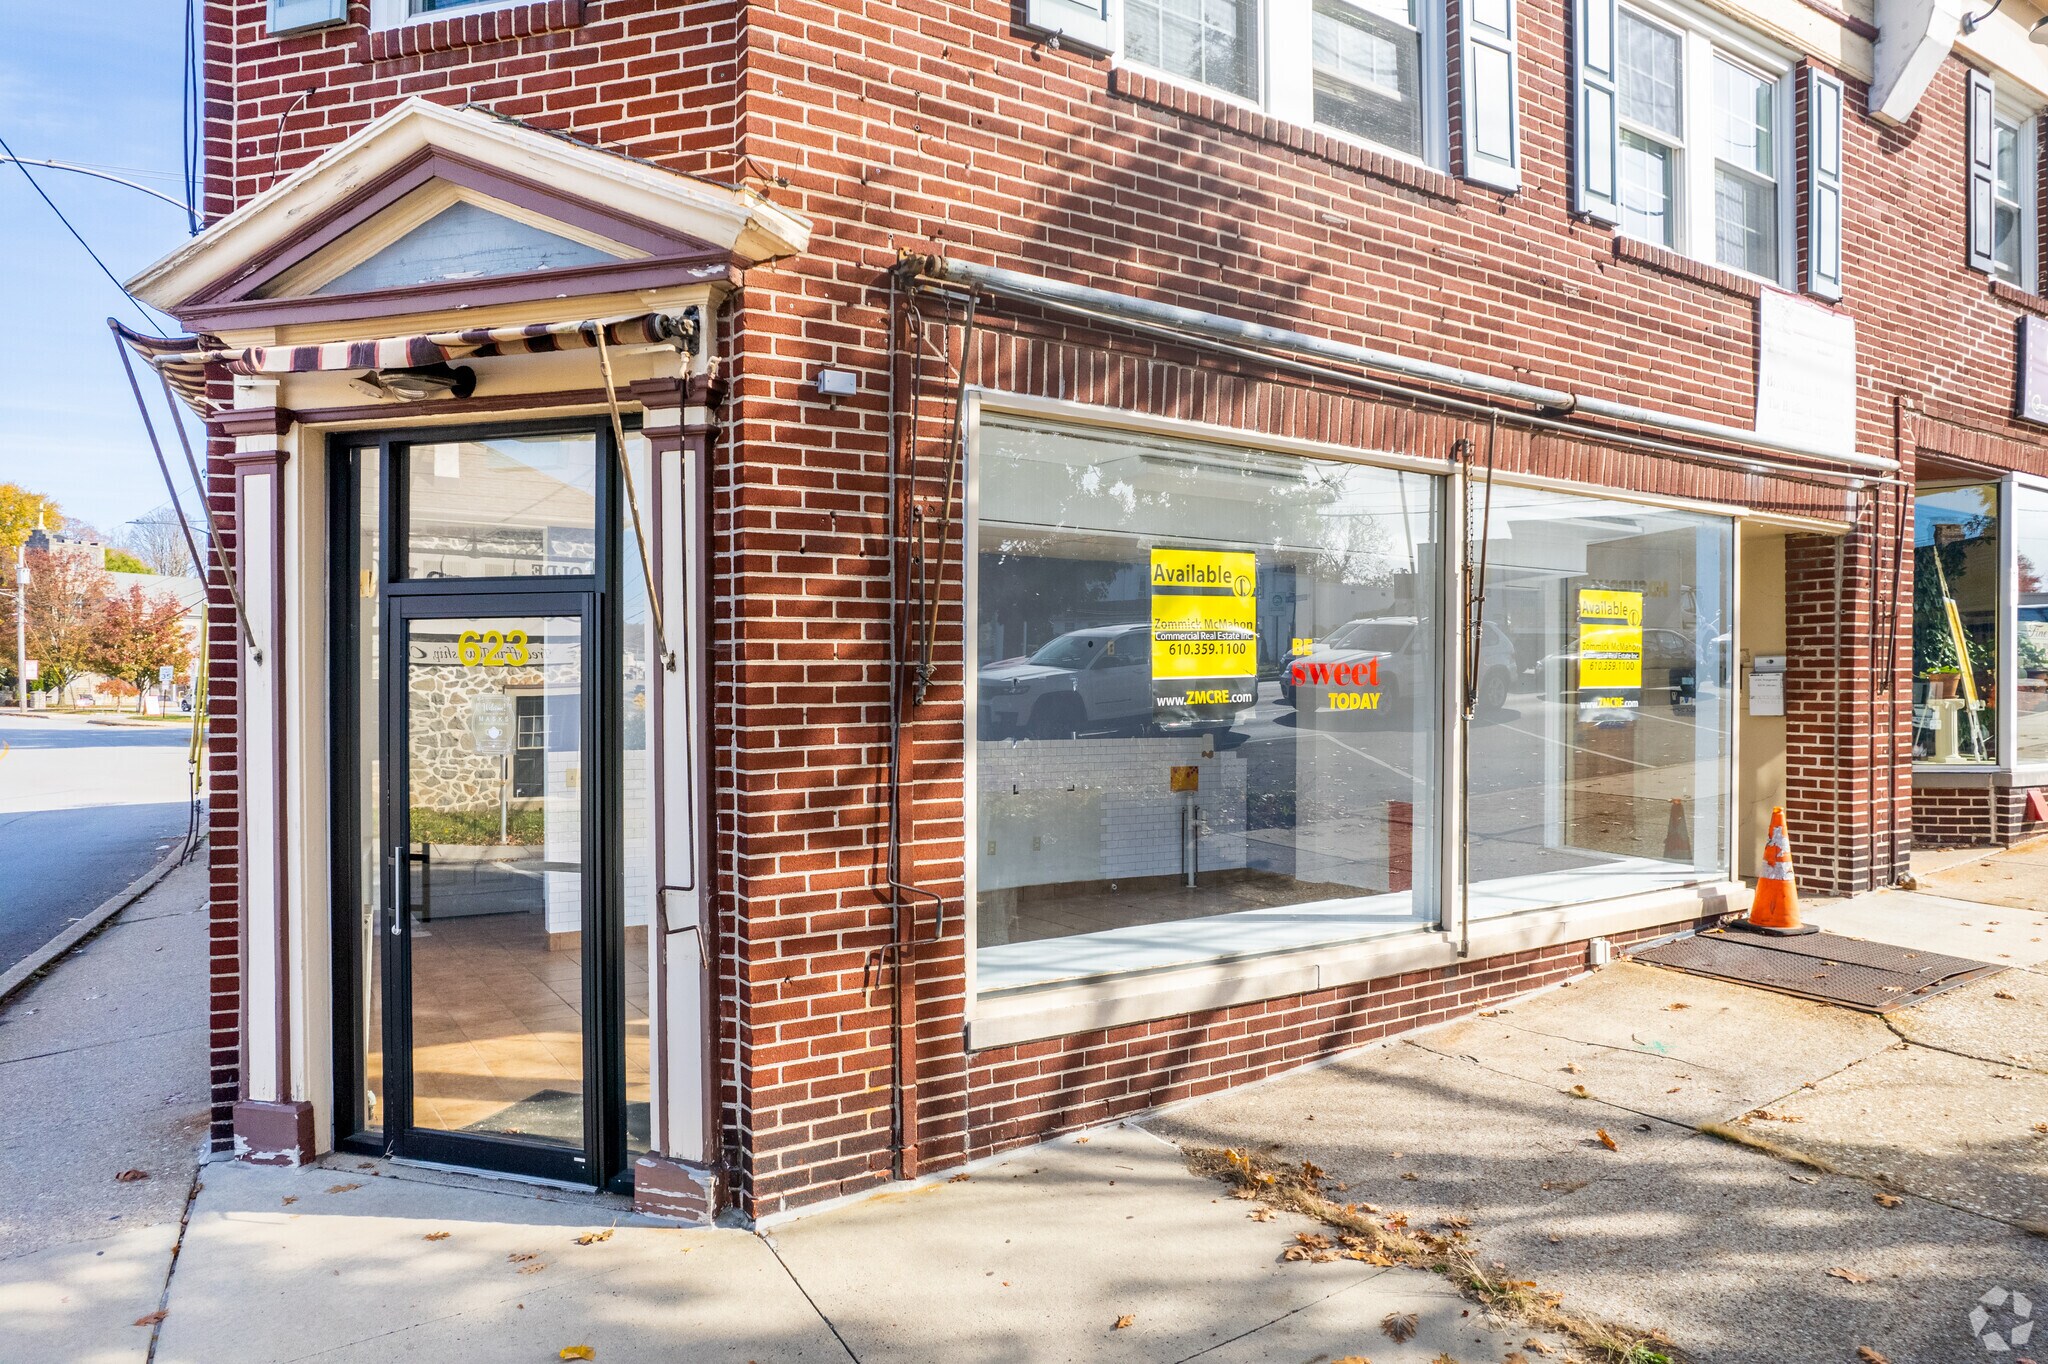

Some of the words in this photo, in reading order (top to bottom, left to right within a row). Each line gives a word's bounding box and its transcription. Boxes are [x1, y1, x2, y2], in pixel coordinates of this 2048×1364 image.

[1153, 564, 1232, 583] Available
[1582, 600, 1628, 616] Available
[1155, 618, 1202, 629] Zommick
[1204, 618, 1253, 630] McMahon
[1156, 631, 1199, 640] Commercial
[1200, 631, 1216, 640] Real
[1217, 631, 1240, 640] Estate
[457, 630, 528, 667] 623
[1169, 643, 1246, 655] 610.359.1100
[1292, 637, 1313, 656] BE
[1291, 656, 1380, 686] sweet
[1590, 661, 1635, 671] 610.359.1100
[1156, 689, 1252, 706] www.ZMCRE.com
[1328, 692, 1380, 710] TODAY
